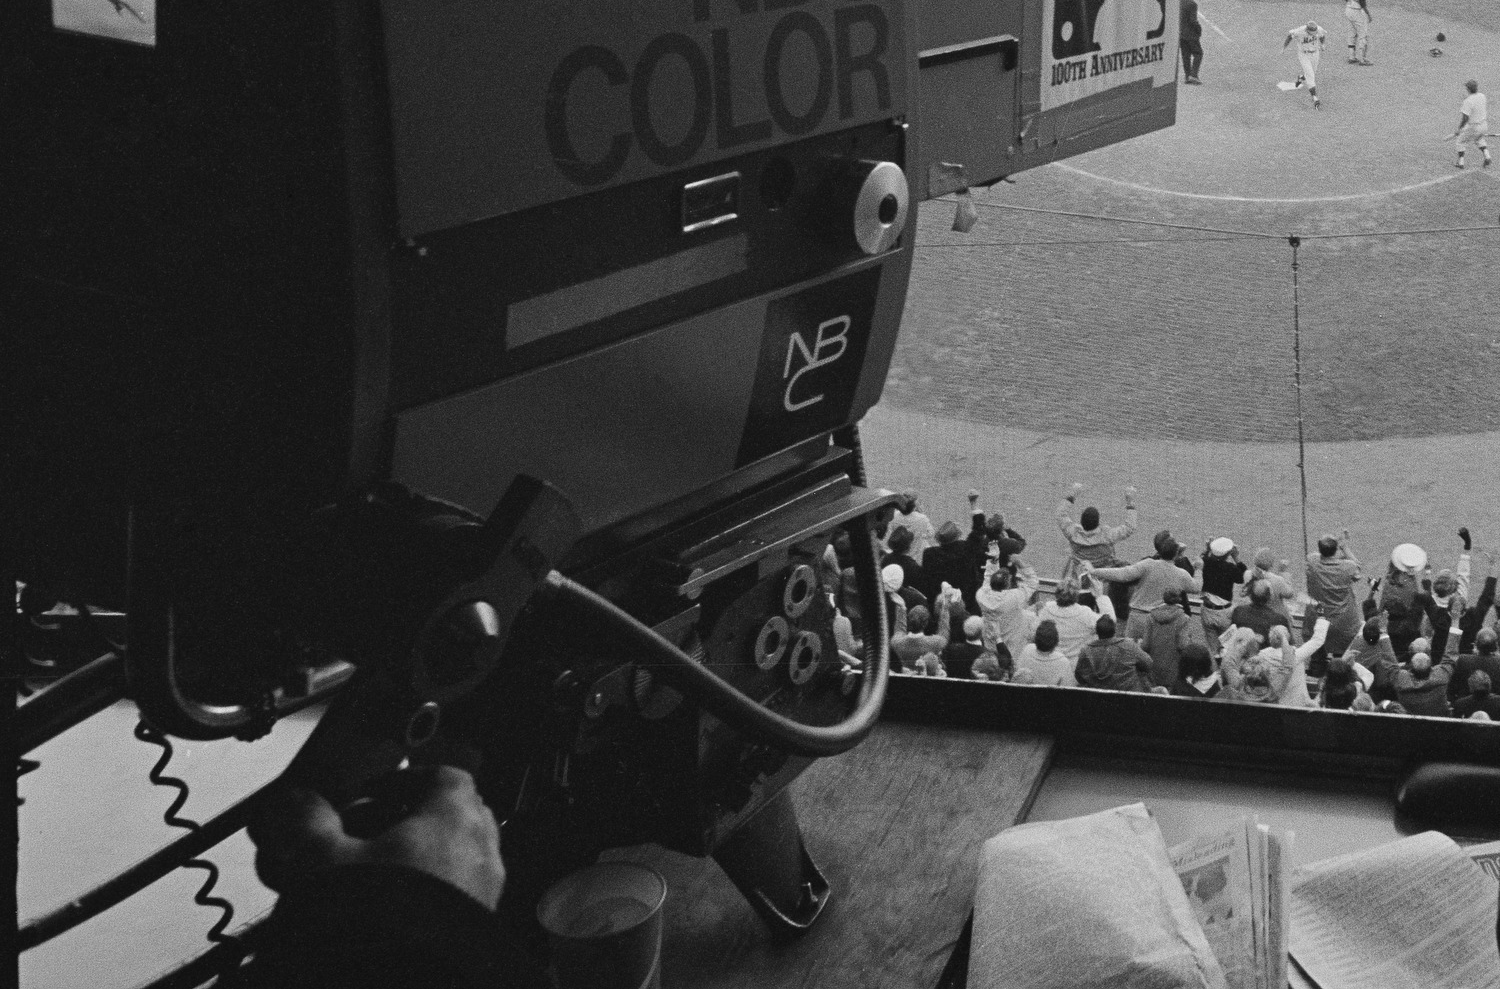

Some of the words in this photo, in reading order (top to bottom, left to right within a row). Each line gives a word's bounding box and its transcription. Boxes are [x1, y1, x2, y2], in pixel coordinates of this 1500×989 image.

[542, 3, 893, 187] COLOR
[1050, 60, 1088, 87] 100TH
[1089, 42, 1165, 78] ANNIVERSARY
[783, 314, 852, 411] NBC
